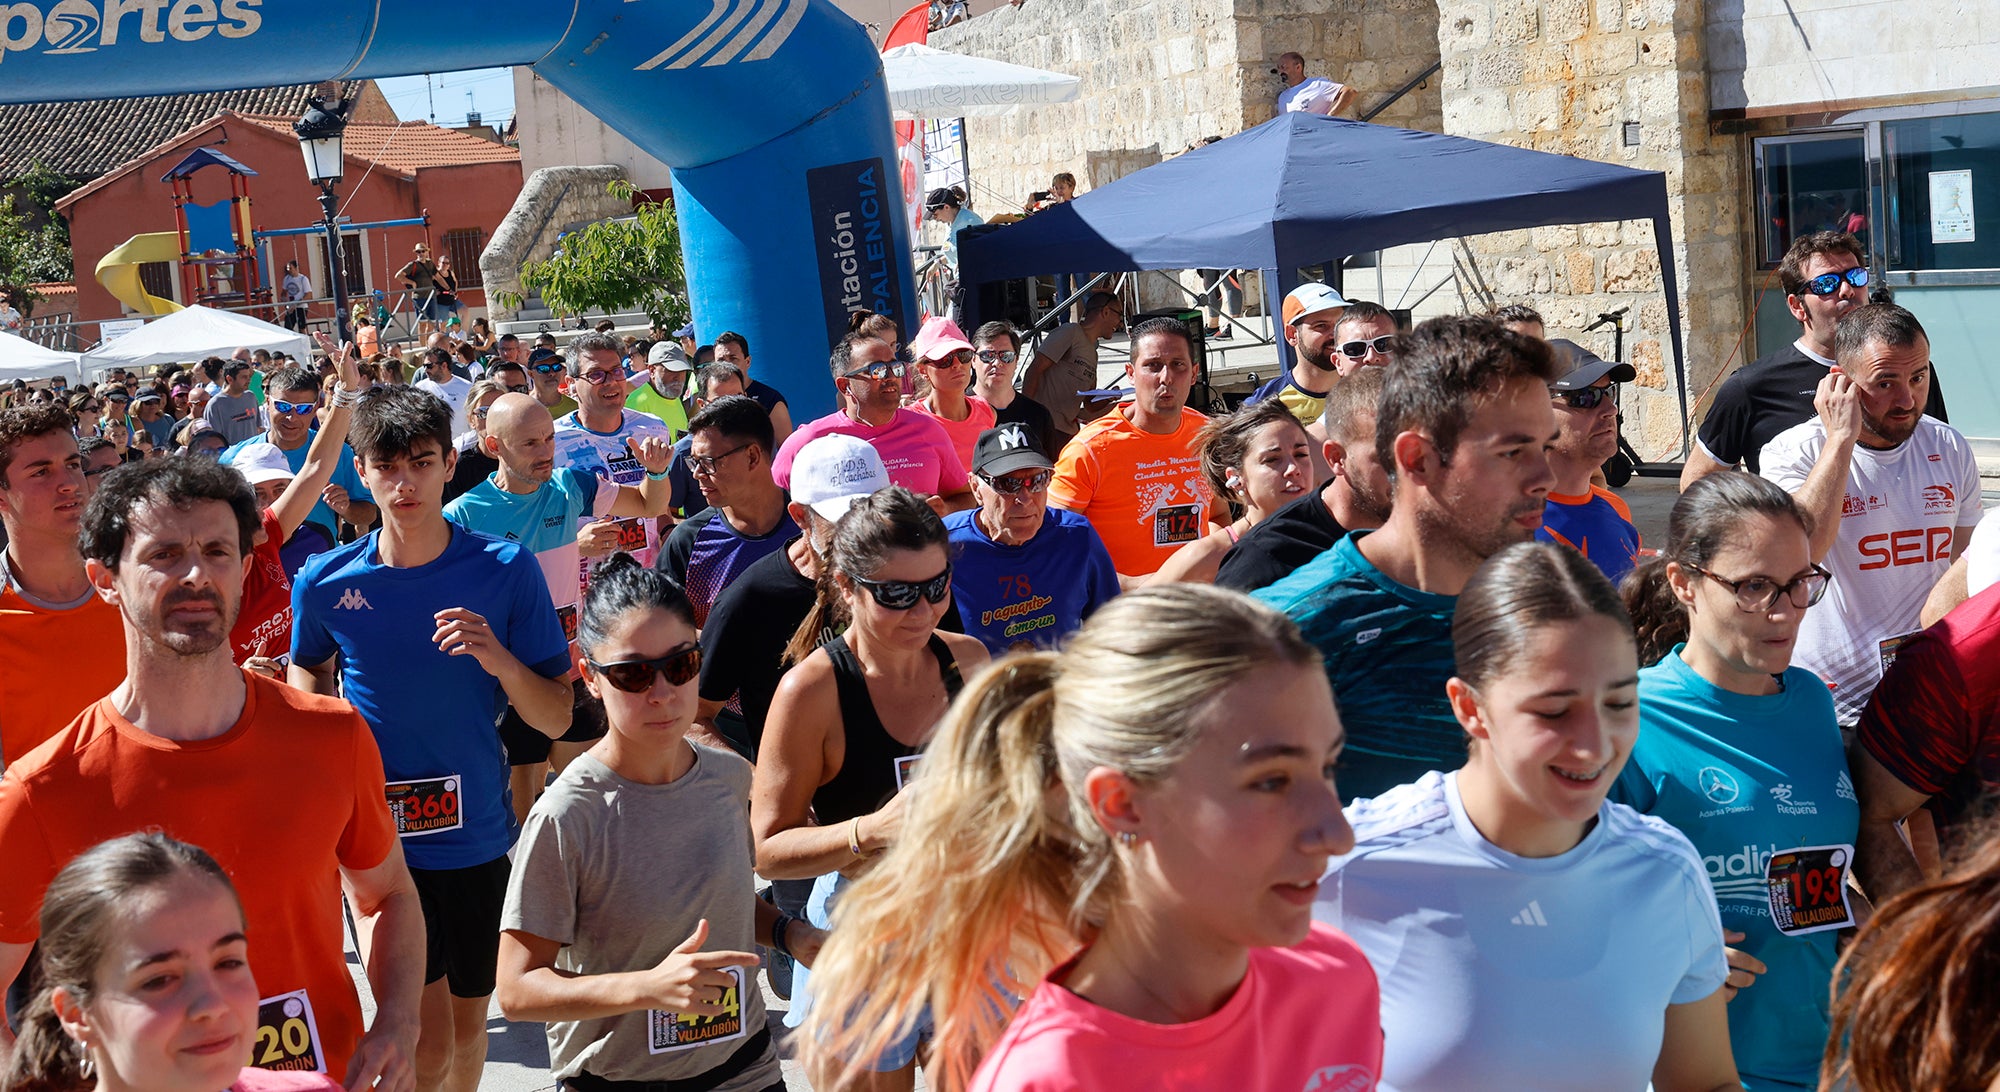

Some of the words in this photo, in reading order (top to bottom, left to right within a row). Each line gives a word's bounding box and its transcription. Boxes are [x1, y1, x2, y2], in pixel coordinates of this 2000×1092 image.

[858, 165, 893, 315] PALENCIA
[998, 426, 1029, 450] NY
[1134, 470, 1165, 480] Ciudad
[1136, 459, 1167, 469] Media
[1168, 514, 1198, 534] 174
[1858, 526, 1953, 570] SER
[998, 574, 1032, 599] 78
[981, 611, 993, 626] y
[993, 595, 1053, 621] aguanto
[1004, 619, 1038, 637] como
[1037, 614, 1056, 628] un
[405, 791, 457, 820] 360
[405, 814, 458, 831] VILLALOBÓN
[1791, 866, 1840, 908] 193
[1791, 903, 1846, 926] VILLALOBÓN
[255, 1017, 310, 1066] 20
[677, 1018, 740, 1043] VILLALOBÓN
